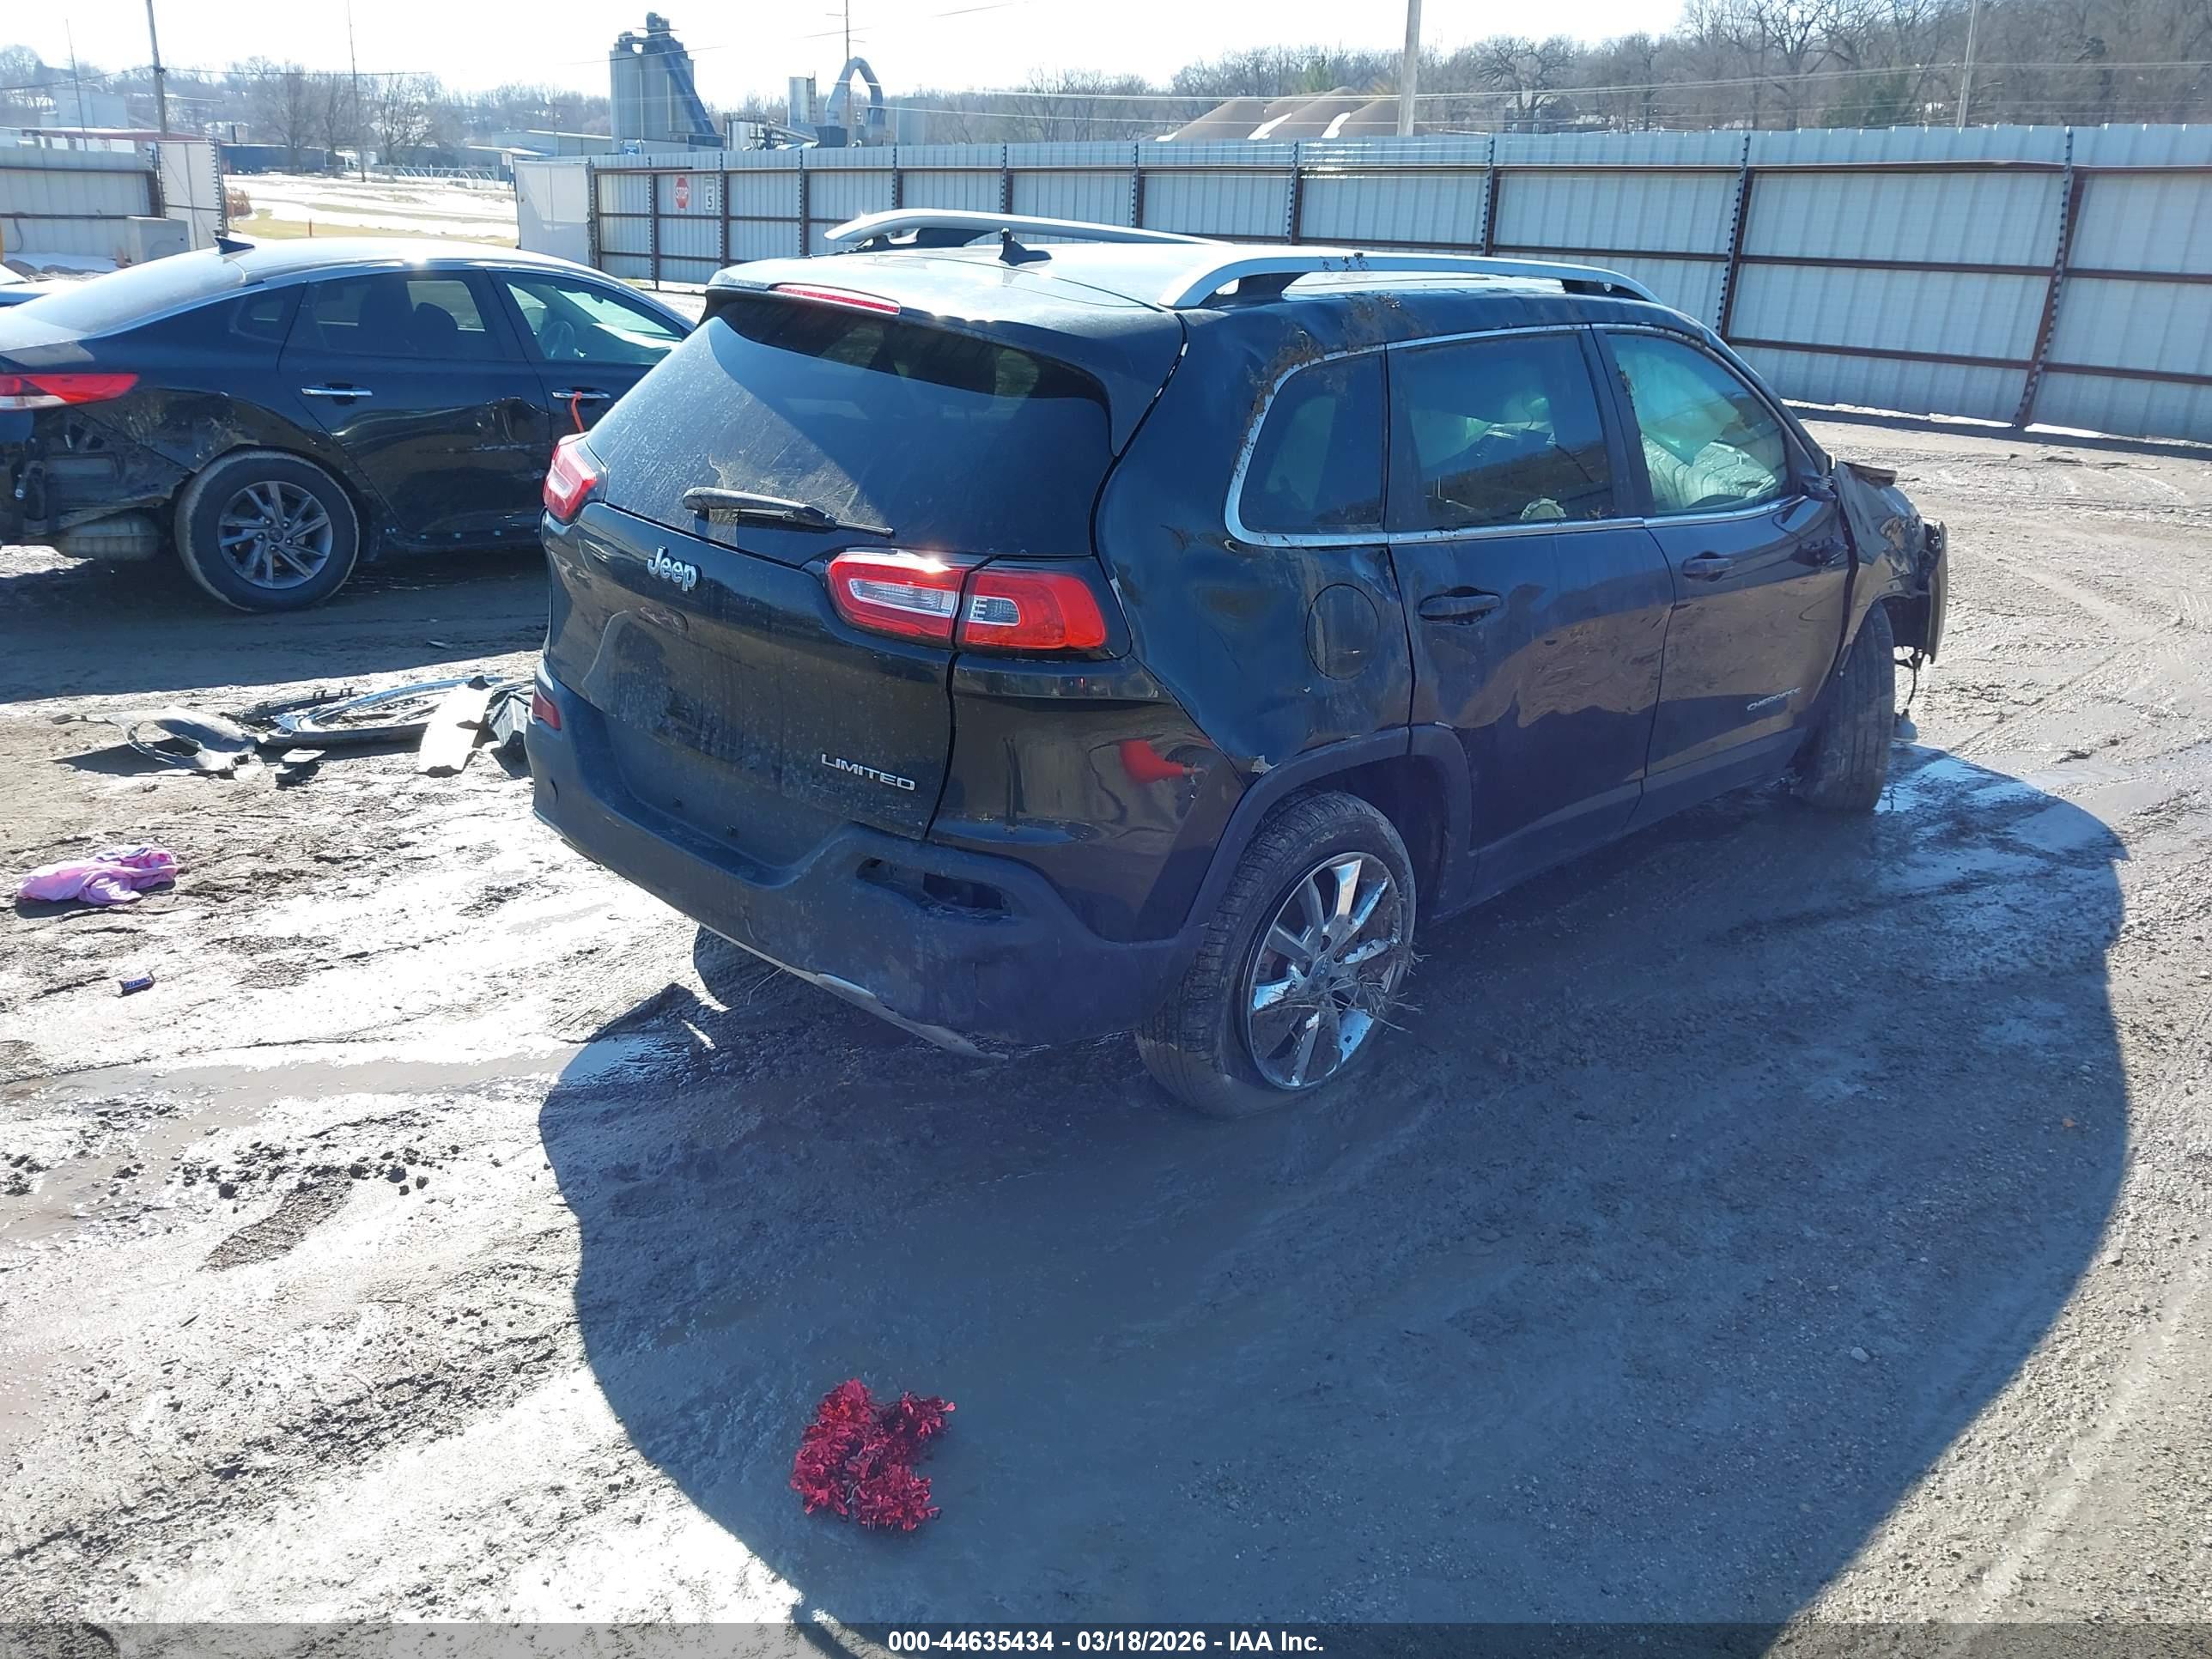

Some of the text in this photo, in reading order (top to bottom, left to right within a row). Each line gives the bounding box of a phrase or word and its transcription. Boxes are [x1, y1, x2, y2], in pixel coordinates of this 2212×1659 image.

[707, 195, 713, 207] 5
[647, 544, 698, 592] Jeep
[821, 753, 915, 791] LIMITED
